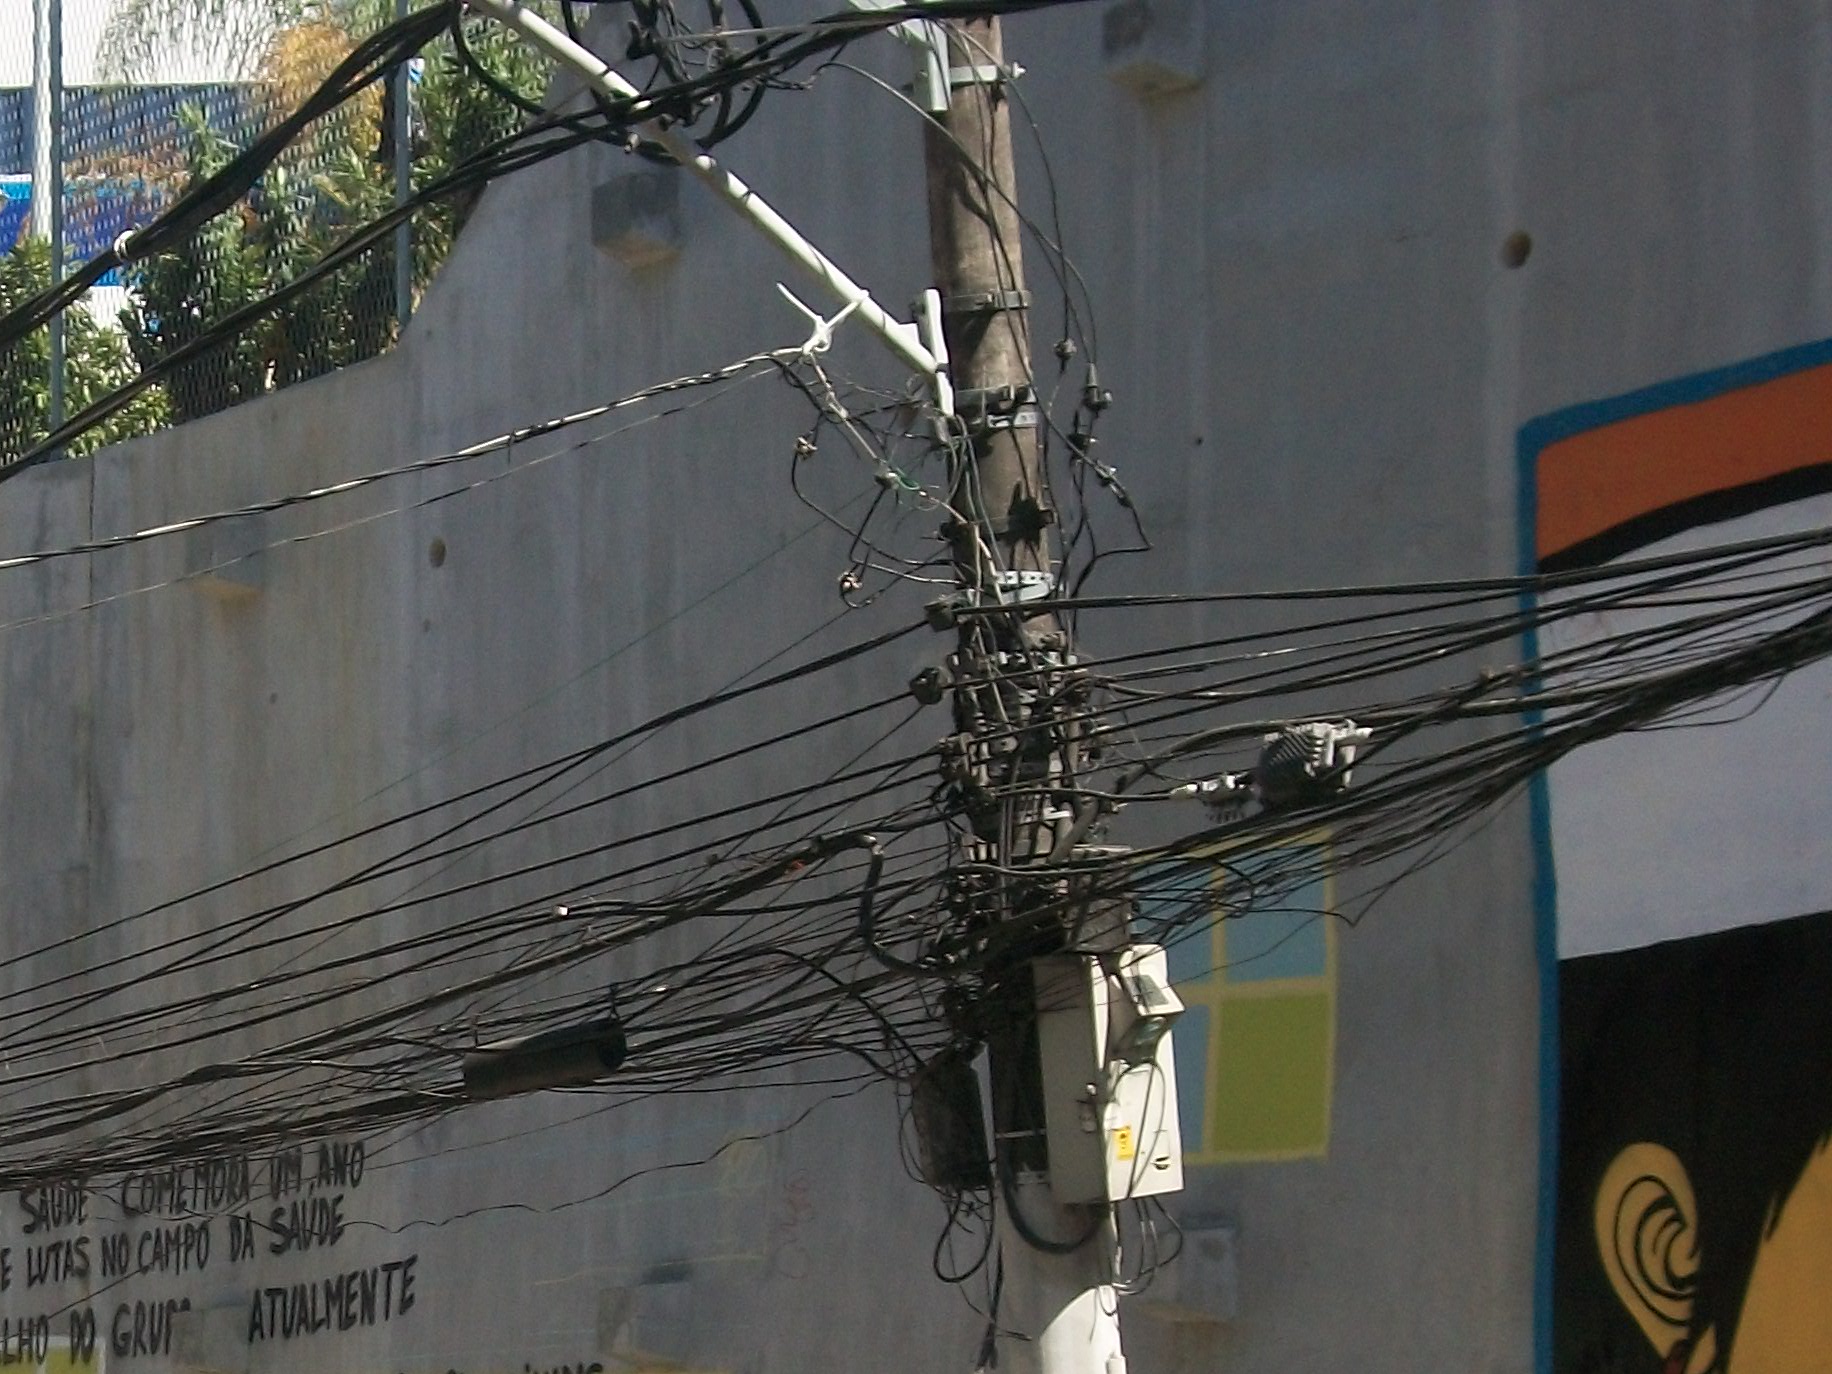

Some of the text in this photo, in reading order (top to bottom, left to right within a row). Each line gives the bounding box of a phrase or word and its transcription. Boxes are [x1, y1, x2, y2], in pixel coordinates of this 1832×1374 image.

[268, 1147, 303, 1199] UM
[317, 1140, 365, 1189] ANO
[0, 1247, 13, 1292] E
[26, 1236, 91, 1288] LUTAS
[101, 1231, 129, 1277] NO
[137, 1221, 211, 1277] CAMPO
[230, 1211, 255, 1264] DA
[67, 1306, 98, 1366] DO
[248, 1253, 419, 1345] ATUALMENTE
